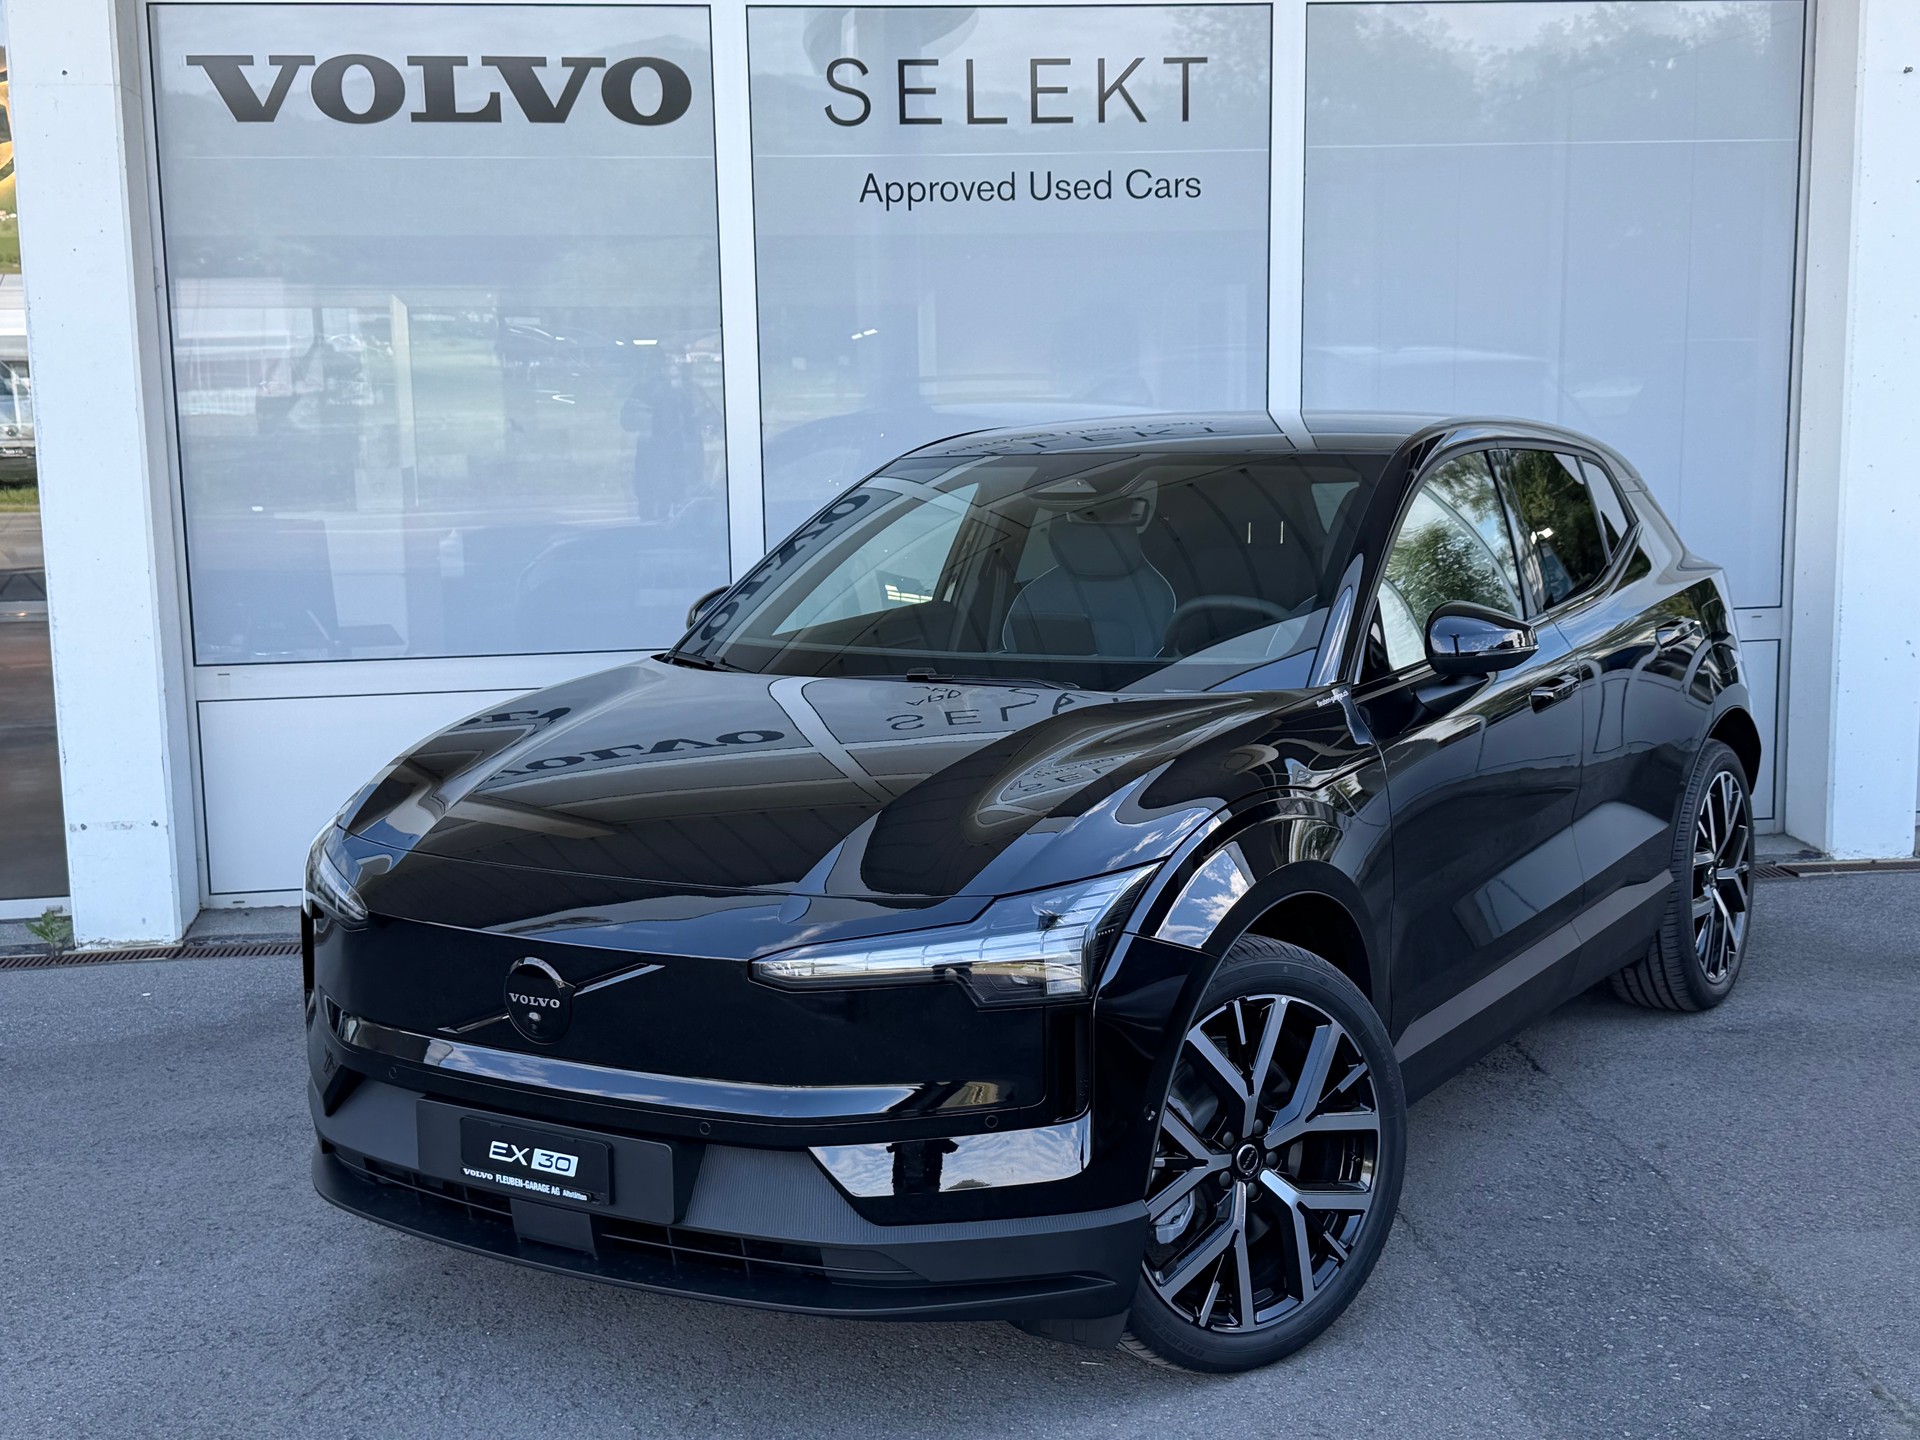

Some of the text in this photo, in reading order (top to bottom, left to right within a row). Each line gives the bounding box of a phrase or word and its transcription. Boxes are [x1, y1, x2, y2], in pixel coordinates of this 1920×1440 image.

[186, 54, 692, 127] VOLVO
[824, 56, 1208, 127] SELEKT
[859, 169, 1202, 212] Approved Used Cars
[508, 992, 561, 1009] VOLVO
[462, 1167, 494, 1181] VOLVO
[550, 1185, 561, 1196] AG
